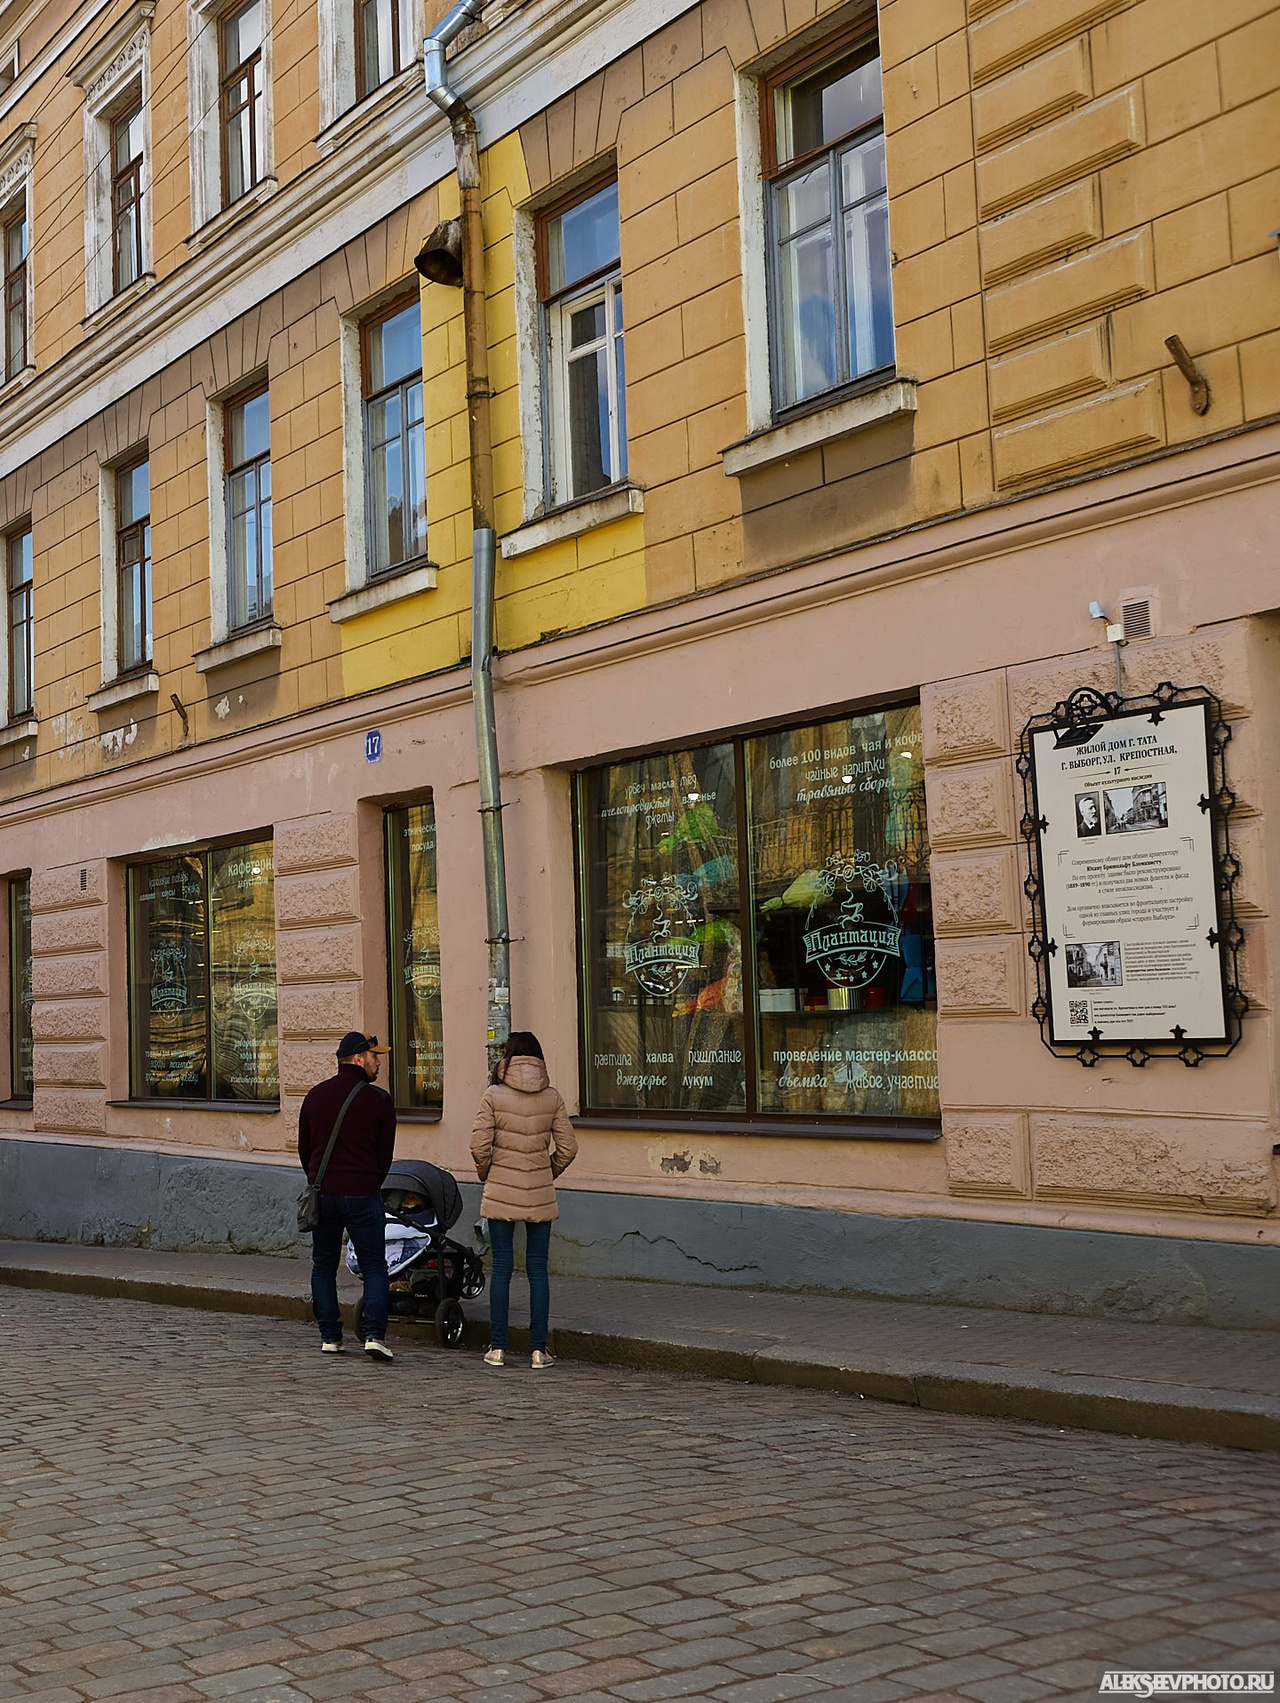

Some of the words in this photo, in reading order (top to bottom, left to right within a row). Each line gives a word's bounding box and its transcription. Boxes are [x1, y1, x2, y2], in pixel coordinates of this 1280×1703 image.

[368, 736, 379, 755] 17
[769, 754, 798, 770] более
[801, 748, 821, 763] 100
[823, 745, 856, 760] видов
[862, 739, 881, 753] чая
[885, 738, 892, 749] и
[895, 731, 923, 747] кофе
[1076, 741, 1106, 756] ЖИЛОЙ
[1107, 740, 1127, 752] ДОМ
[1128, 739, 1136, 748] Г.
[1136, 735, 1158, 746] ТАТА
[805, 766, 838, 782] чайные
[842, 756, 885, 777] напитки
[1061, 762, 1068, 771] Г.
[1102, 754, 1116, 764] УЛ.
[1113, 767, 1121, 775] 17
[625, 782, 645, 800] урбеч
[650, 779, 675, 792] масла
[796, 783, 857, 805] травяные
[859, 776, 896, 794] сборы
[601, 797, 670, 818] пчелопродукты
[682, 791, 716, 805] ваенье
[645, 811, 675, 831] джемы
[411, 840, 434, 853] посуда
[228, 858, 275, 878] кафетери
[809, 931, 896, 953] Плантация
[629, 943, 698, 965] Плантация
[405, 965, 441, 979] Плантаци
[594, 1053, 632, 1069] пастила
[646, 1052, 674, 1063] халва
[773, 1050, 842, 1064] проведение
[616, 1068, 668, 1091] джезерье
[682, 1075, 713, 1089] лукум
